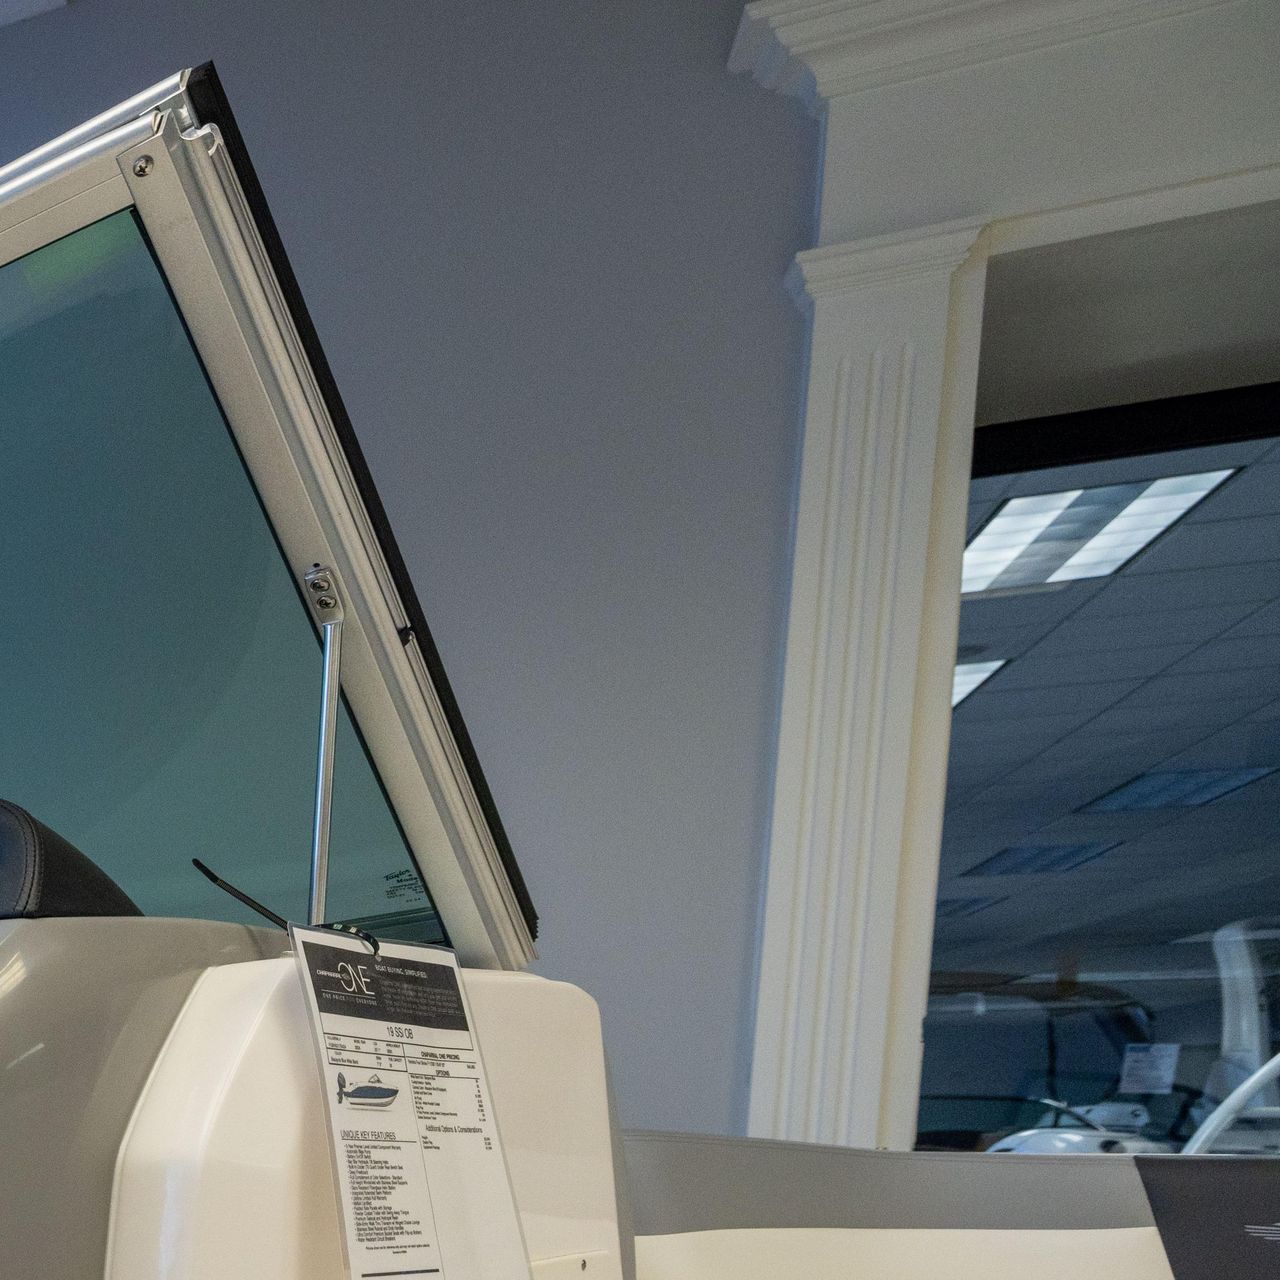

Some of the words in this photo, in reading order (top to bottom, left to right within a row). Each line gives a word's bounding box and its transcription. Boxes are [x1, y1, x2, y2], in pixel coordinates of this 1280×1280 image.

[383, 869, 411, 881] Taylor
[337, 962, 375, 995] ONE
[386, 1026, 394, 1037] 19
[404, 1028, 413, 1039] OB
[340, 1130, 360, 1139] UNIQUE
[360, 1131, 371, 1139] KEY
[371, 1131, 397, 1140] FEATURES
